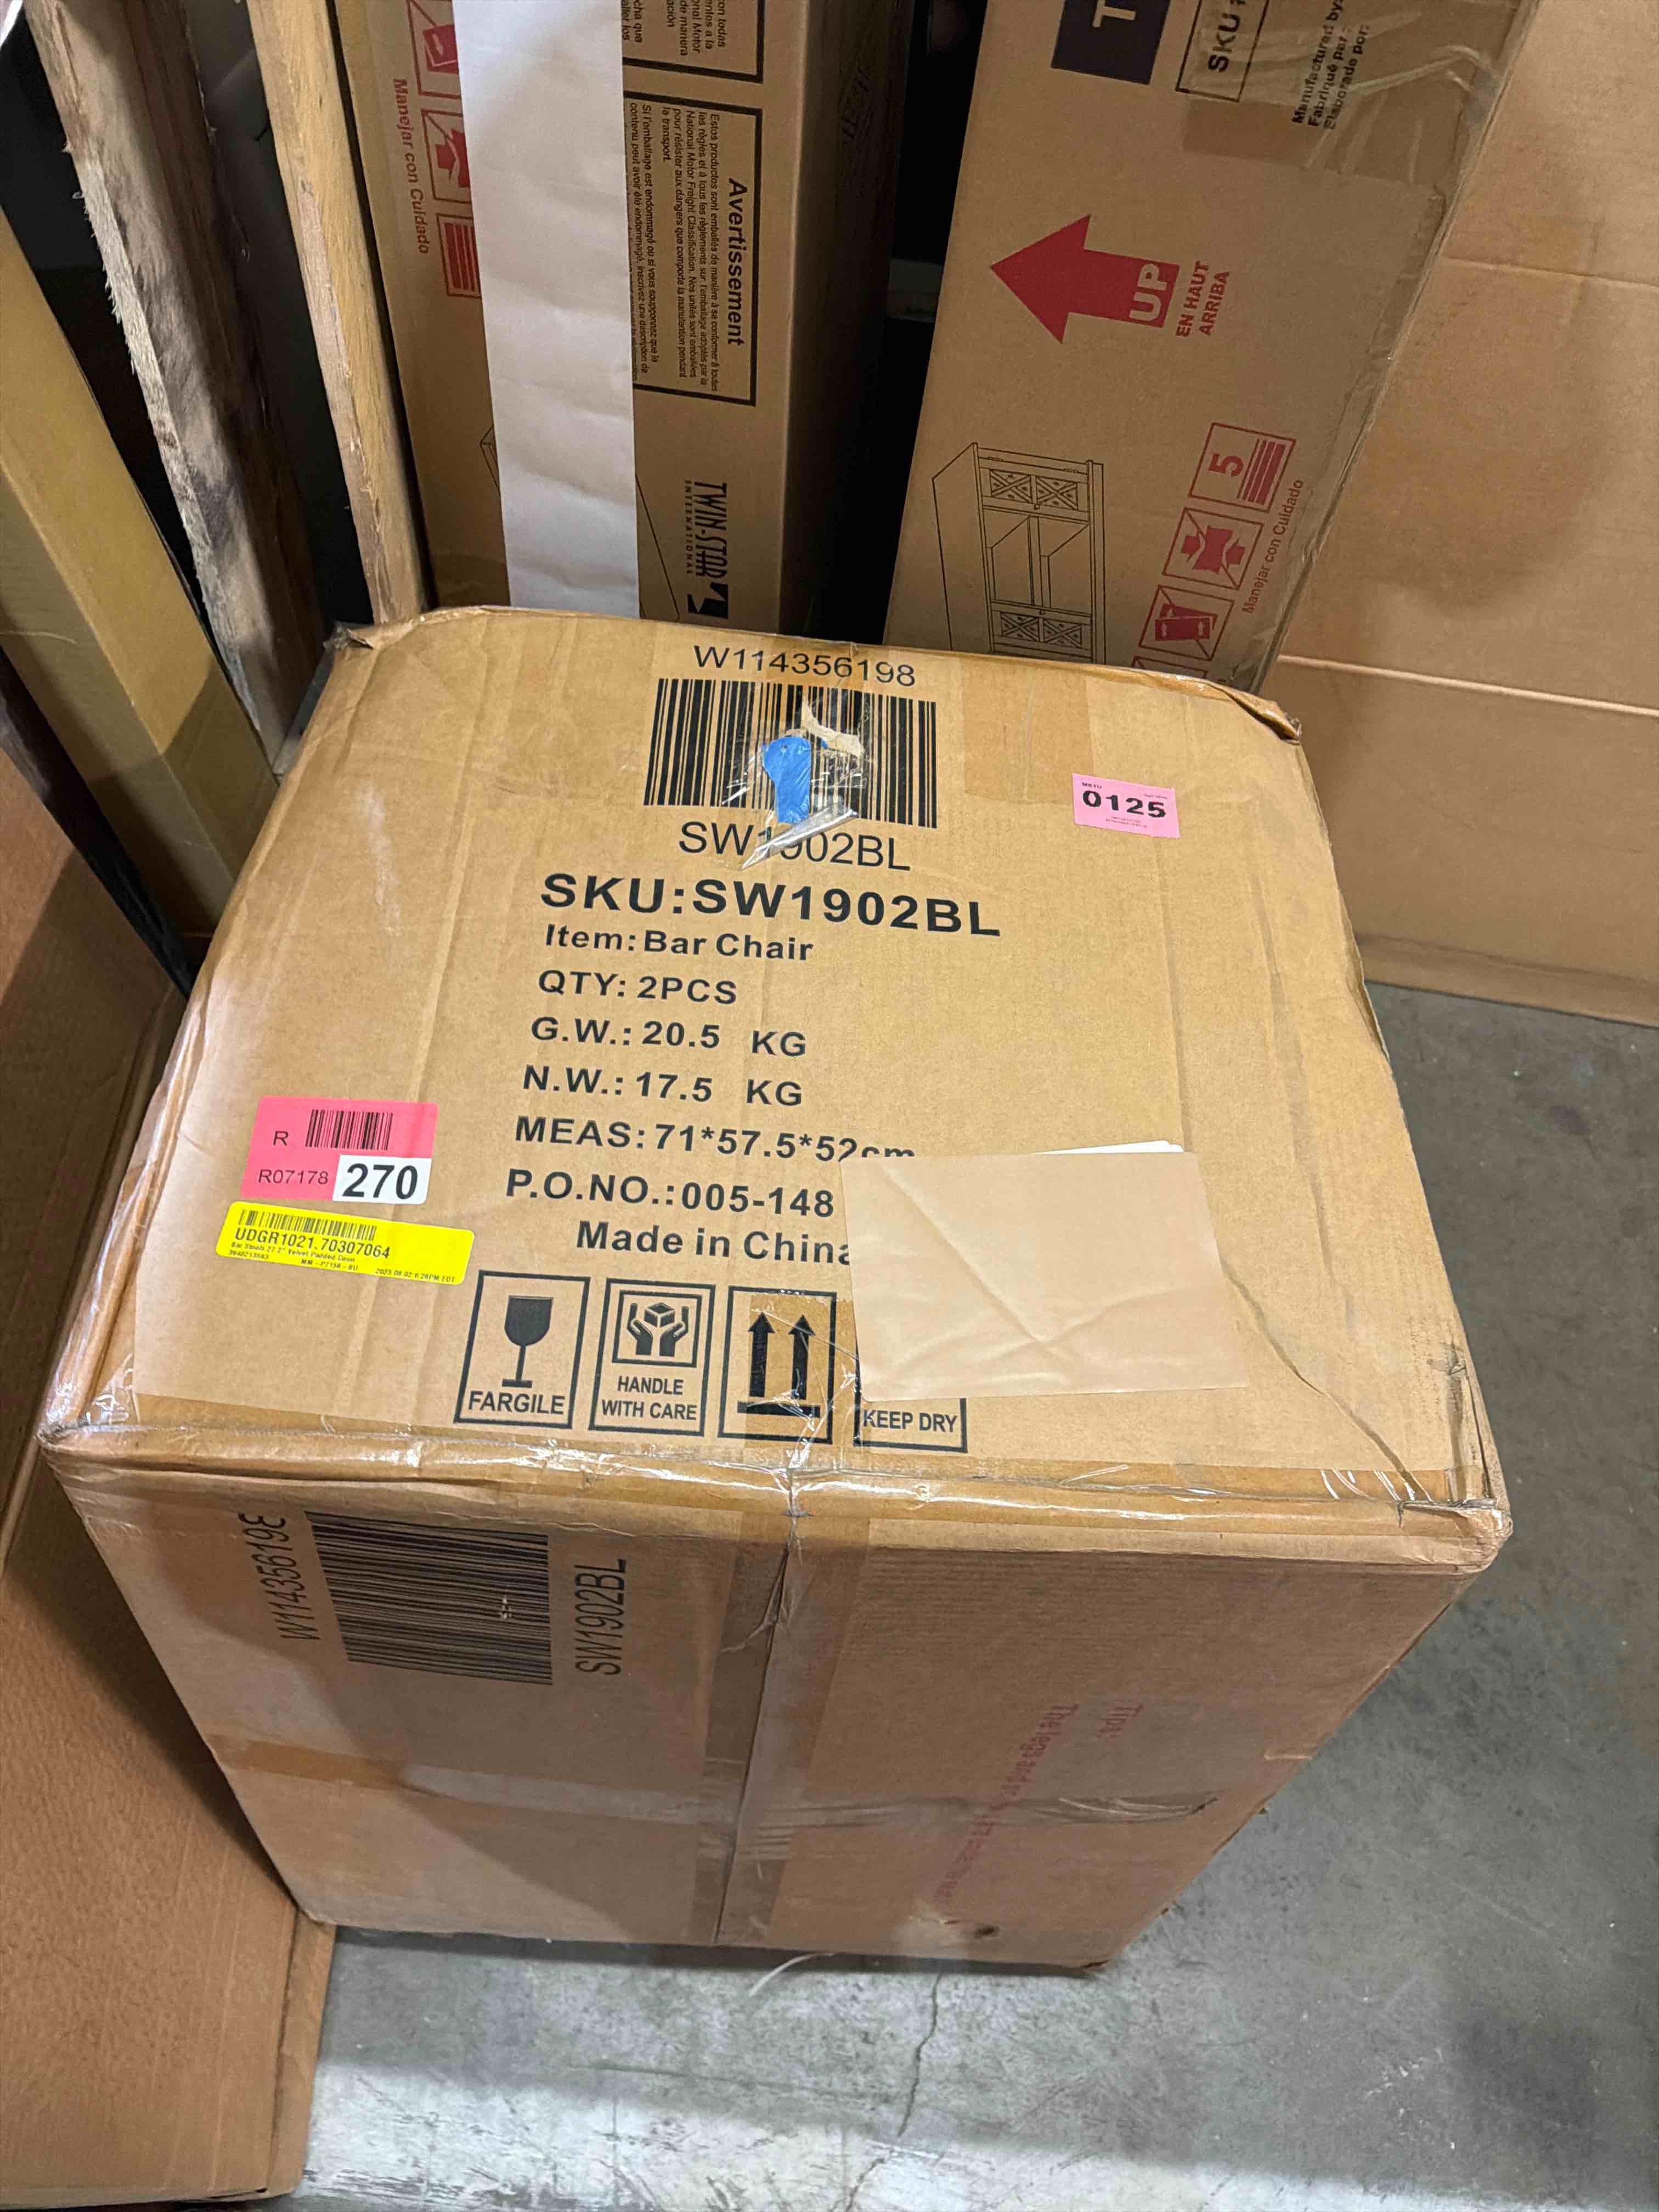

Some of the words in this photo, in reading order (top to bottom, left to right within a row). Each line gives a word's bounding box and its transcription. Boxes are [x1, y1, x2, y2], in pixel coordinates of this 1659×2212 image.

[692, 22, 702, 54] Motor
[718, 19, 727, 48] todas
[1207, 13, 1242, 72] SKU
[1291, 25, 1335, 124] Manufactured
[392, 78, 414, 148] Manejar
[673, 109, 682, 129] pour
[686, 110, 695, 149] National
[405, 153, 419, 183] con
[687, 152, 695, 182] Motor
[673, 190, 684, 225] dangers
[684, 182, 696, 213] Freight
[710, 192, 720, 210] sont
[410, 188, 430, 253] Cuidado
[727, 178, 748, 346] Avertissement
[1128, 263, 1170, 323] UP
[1176, 315, 1194, 338] EN
[1186, 261, 1210, 312] HAUT
[1198, 271, 1230, 336] ARRIBA
[1209, 453, 1244, 477] 5
[1272, 479, 1304, 536] Cuidado
[1265, 540, 1282, 563] con
[1242, 566, 1271, 614] Manejar
[693, 645, 916, 687] W114356198
[1082, 790, 1166, 818] 0125
[540, 873, 1001, 937] SKU:SW1902BL
[715, 934, 814, 961] Chair
[752, 1030, 806, 1057] KG
[746, 1079, 802, 1106] KG
[273, 1131, 289, 1146] R
[258, 1169, 329, 1185] R07178
[342, 1163, 419, 1200] 270
[234, 1227, 392, 1260] UDGR1021.70307064
[576, 1221, 684, 1255] Made
[696, 1228, 731, 1259] in
[617, 1375, 684, 1396] HANDLE
[468, 1390, 566, 1417] FARGILE
[601, 1399, 648, 1419] WITH
[650, 1402, 697, 1421] CARE
[862, 1409, 913, 1429] KEEP
[919, 1413, 958, 1433] DRY
[574, 1559, 627, 1677] SW1902BL
